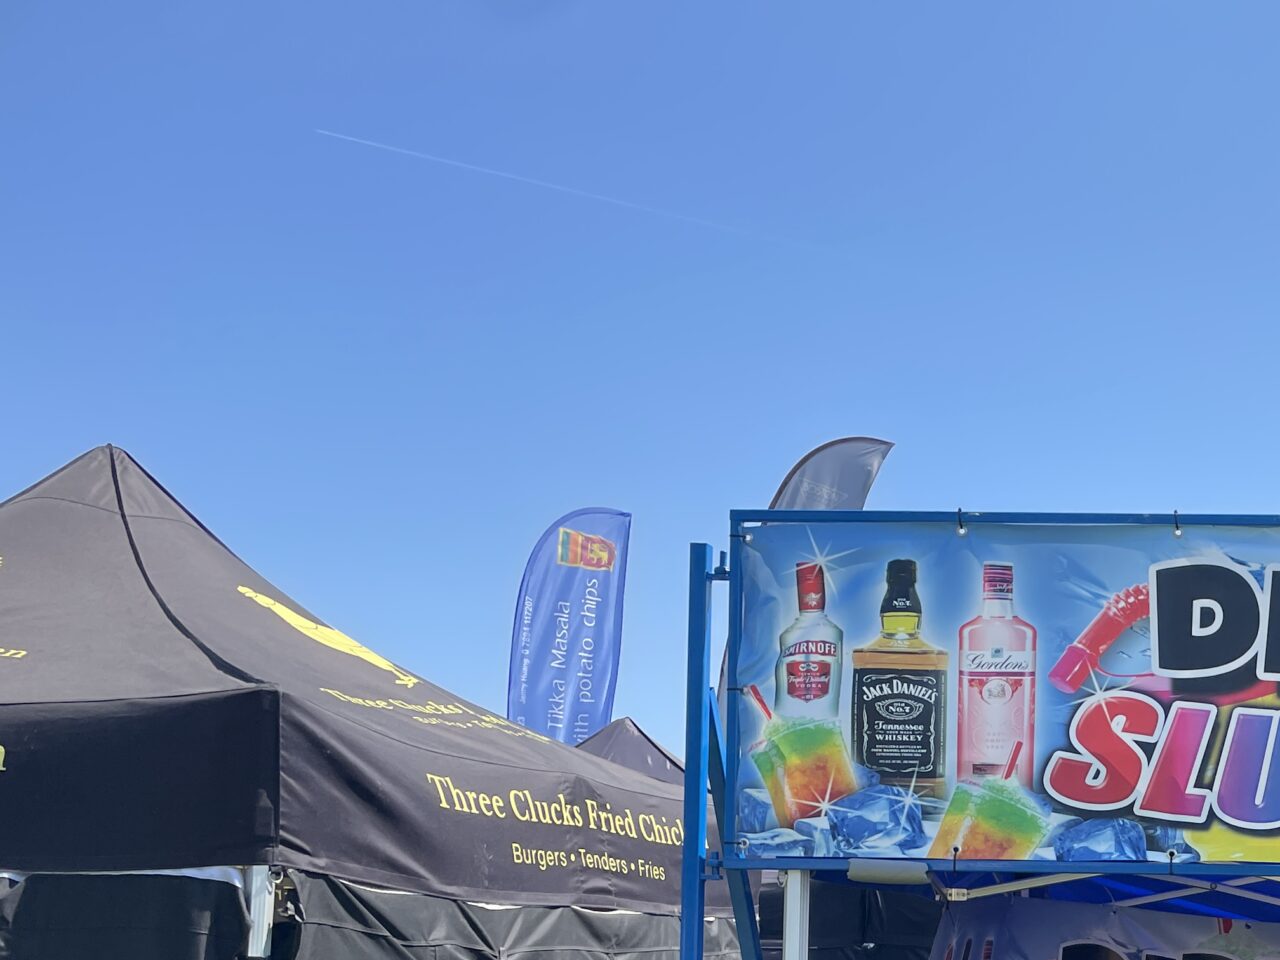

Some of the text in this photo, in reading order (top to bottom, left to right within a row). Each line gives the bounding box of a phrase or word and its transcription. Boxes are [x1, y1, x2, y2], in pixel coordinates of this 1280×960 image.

[580, 578, 602, 627] chips
[547, 601, 570, 729] Tikka Masala
[577, 638, 595, 703] potato
[862, 679, 938, 704] JACK DANIEL'S
[874, 720, 924, 730] Tennessee
[426, 773, 684, 847] Three Clucks Fried Chic
[511, 842, 666, 881] Burgers Tenders Fries
